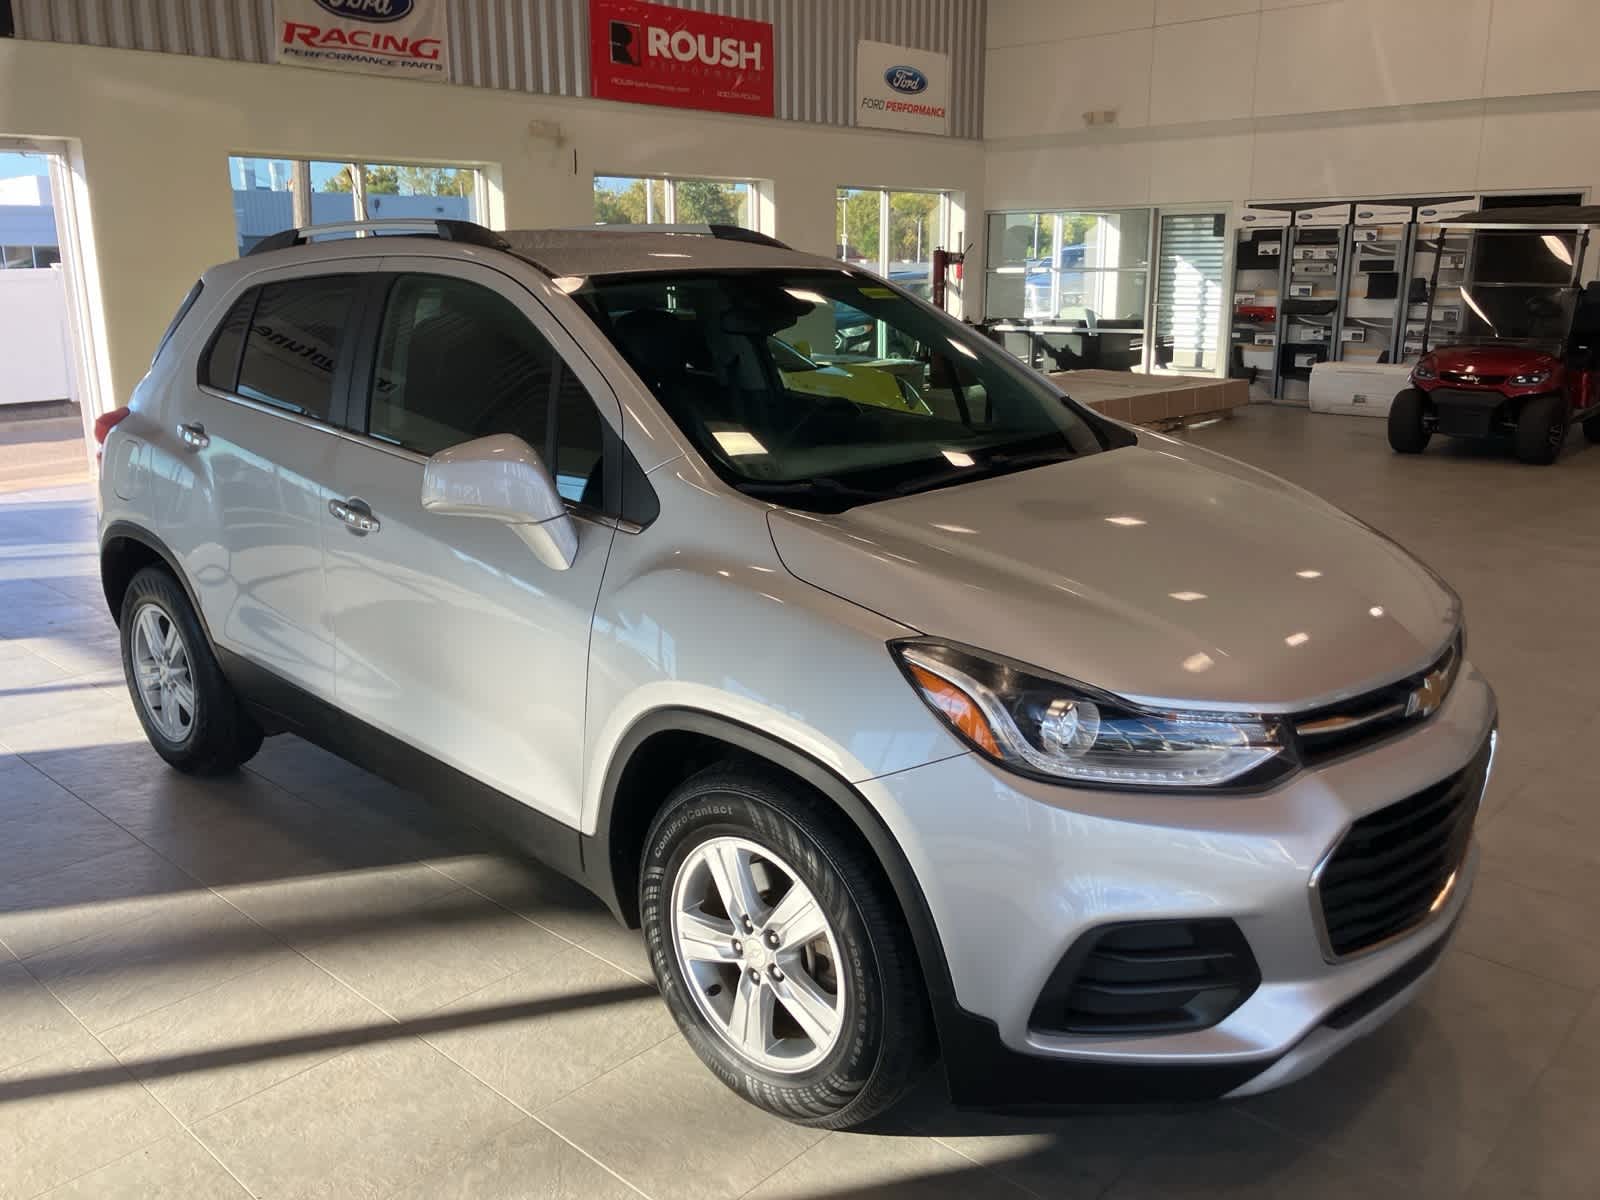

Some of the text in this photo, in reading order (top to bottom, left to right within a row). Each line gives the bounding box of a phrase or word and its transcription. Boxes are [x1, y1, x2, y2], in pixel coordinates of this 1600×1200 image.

[283, 21, 441, 60] RACING
[648, 26, 761, 71] ROUSH
[284, 48, 442, 71] PERFORMANCE PARTS
[892, 69, 920, 90] Ford
[861, 98, 945, 118] FORD PERFORMANCE
